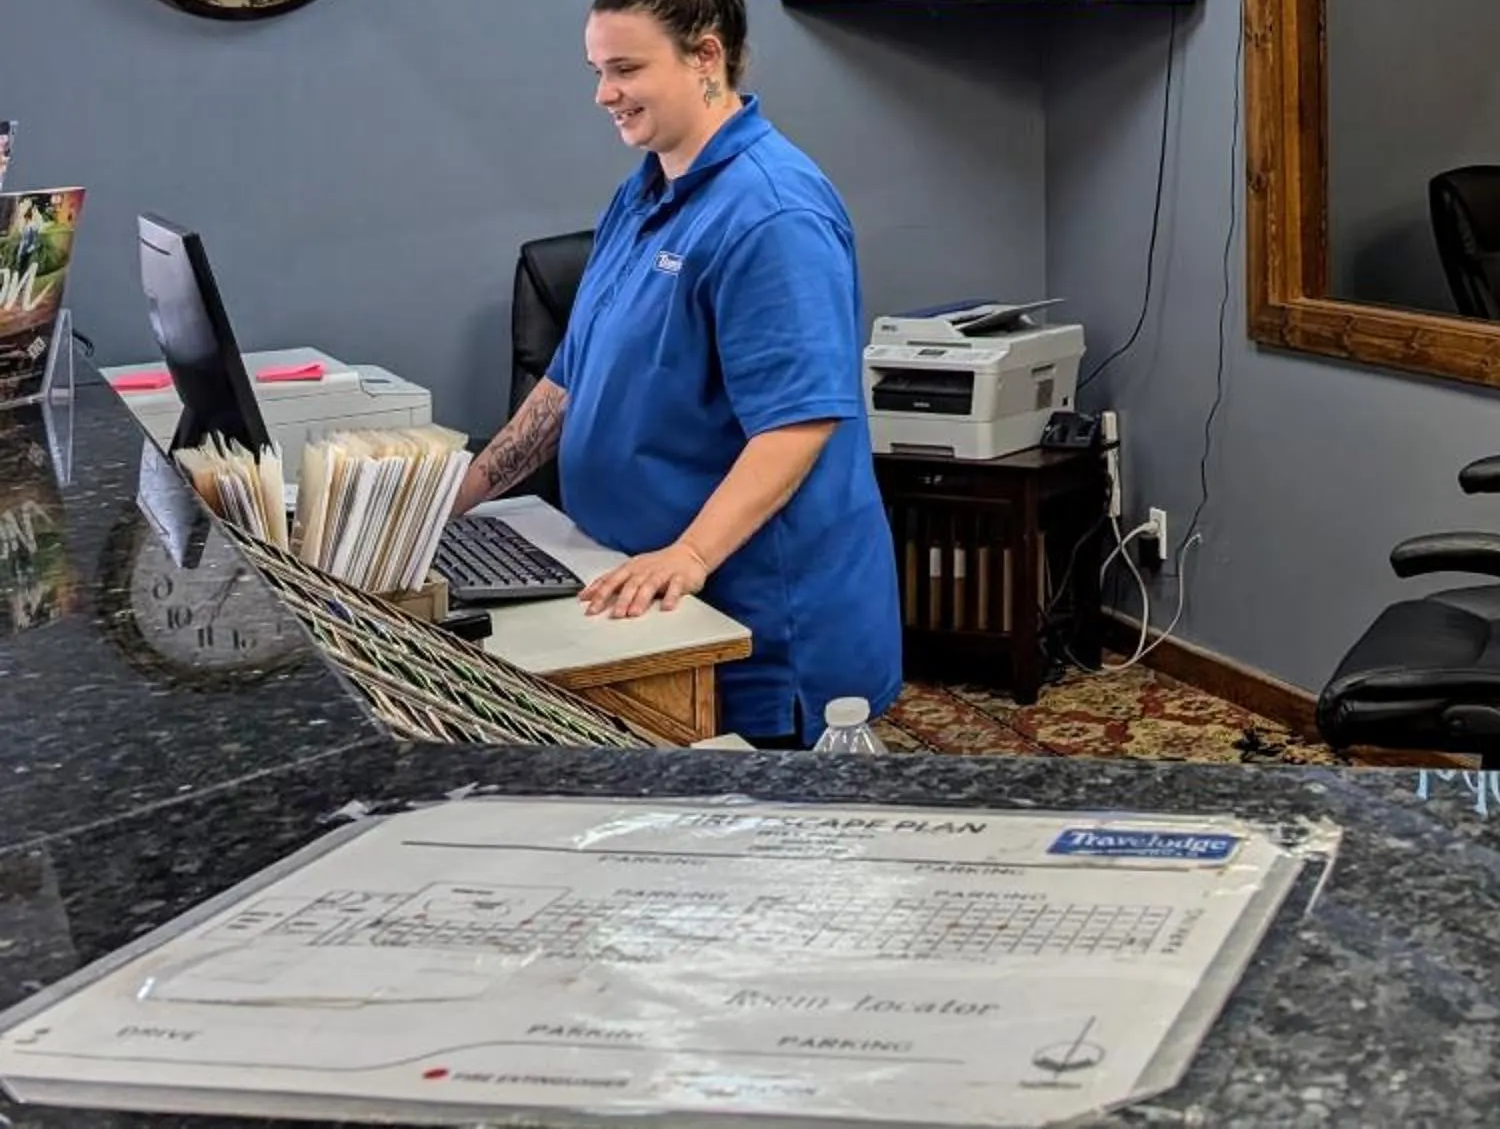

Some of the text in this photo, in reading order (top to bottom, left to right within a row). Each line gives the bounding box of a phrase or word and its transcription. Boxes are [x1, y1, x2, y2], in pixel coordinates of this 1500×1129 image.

[894, 819, 988, 834] PLAN
[1068, 830, 1229, 854] Travelodge
[777, 1035, 914, 1053] PARKING
